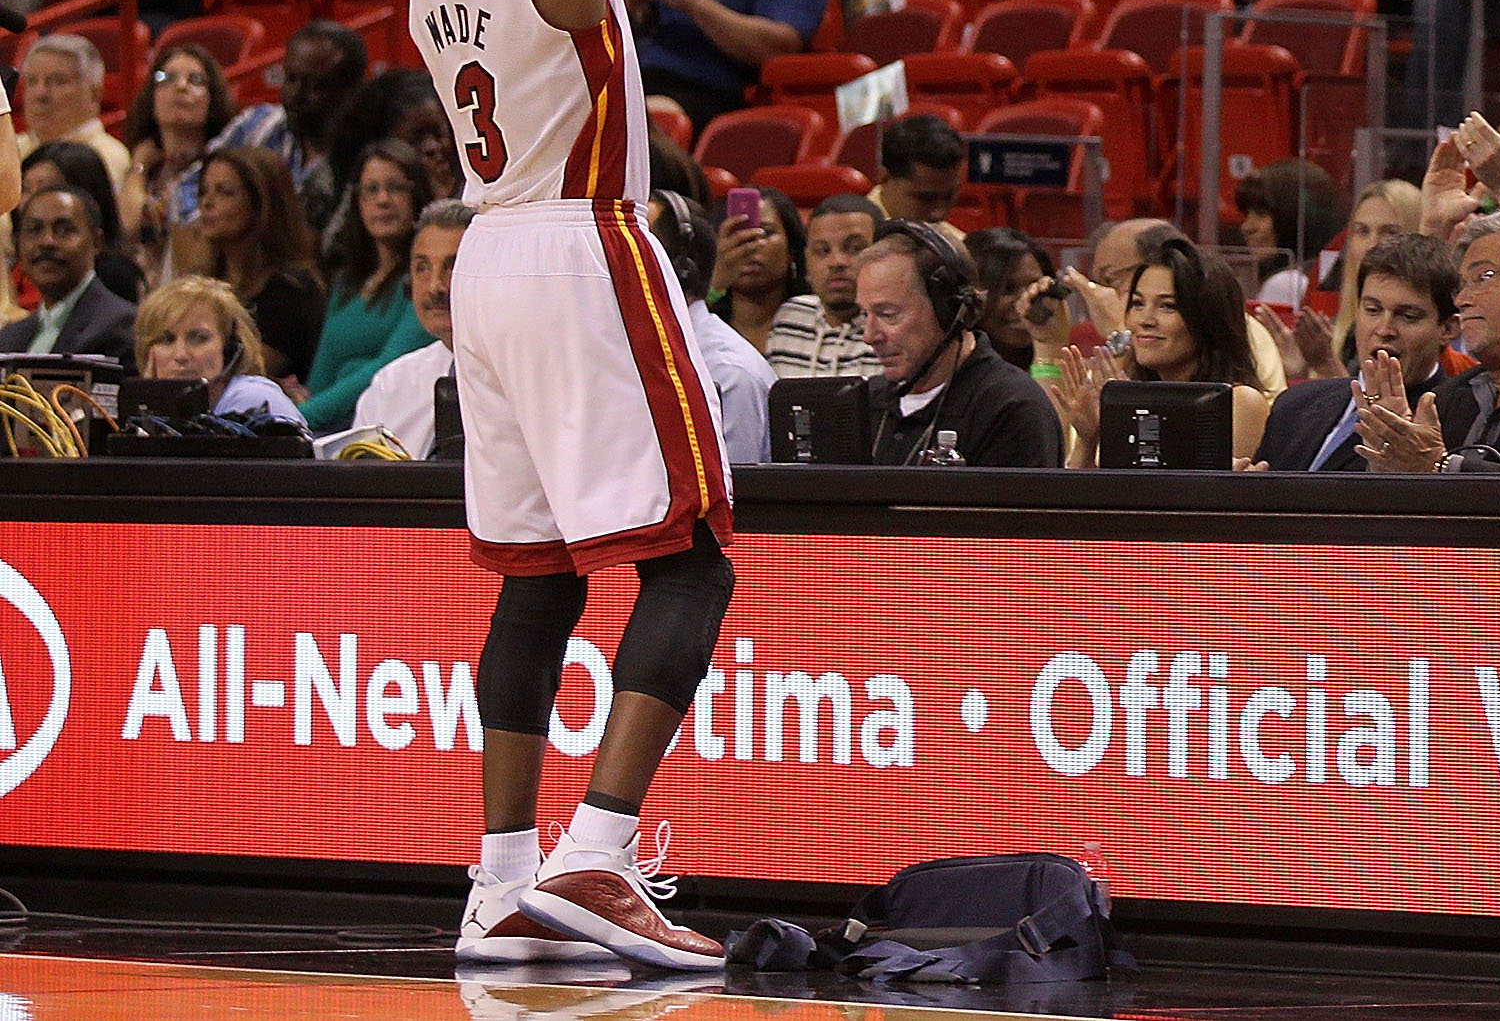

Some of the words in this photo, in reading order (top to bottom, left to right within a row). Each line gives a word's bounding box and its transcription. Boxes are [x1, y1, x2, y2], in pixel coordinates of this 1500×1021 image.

[424, 2, 492, 55] WADE
[453, 59, 510, 186] 3
[120, 625, 485, 753] All-New
[547, 635, 916, 770] Otima
[1029, 649, 1431, 789] Official
